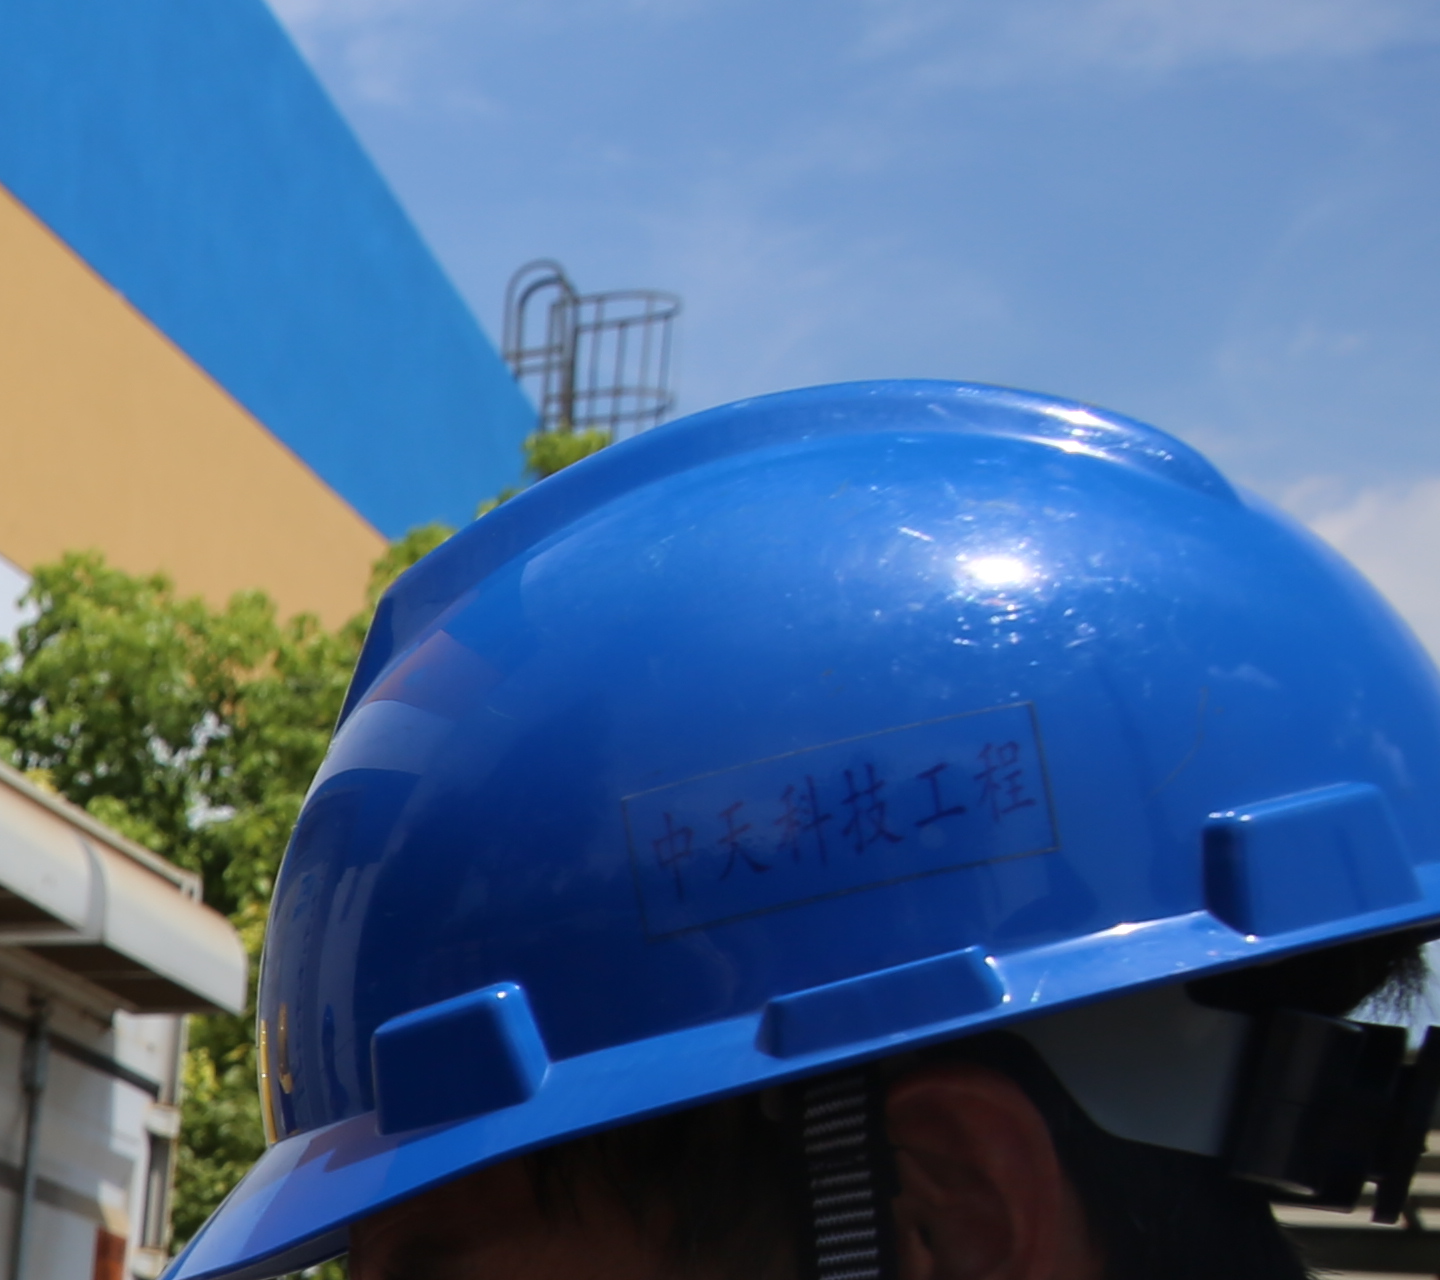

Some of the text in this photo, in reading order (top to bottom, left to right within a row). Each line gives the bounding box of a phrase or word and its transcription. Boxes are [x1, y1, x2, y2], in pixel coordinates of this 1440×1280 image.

[651, 739, 1036, 900] 中天科技工程
